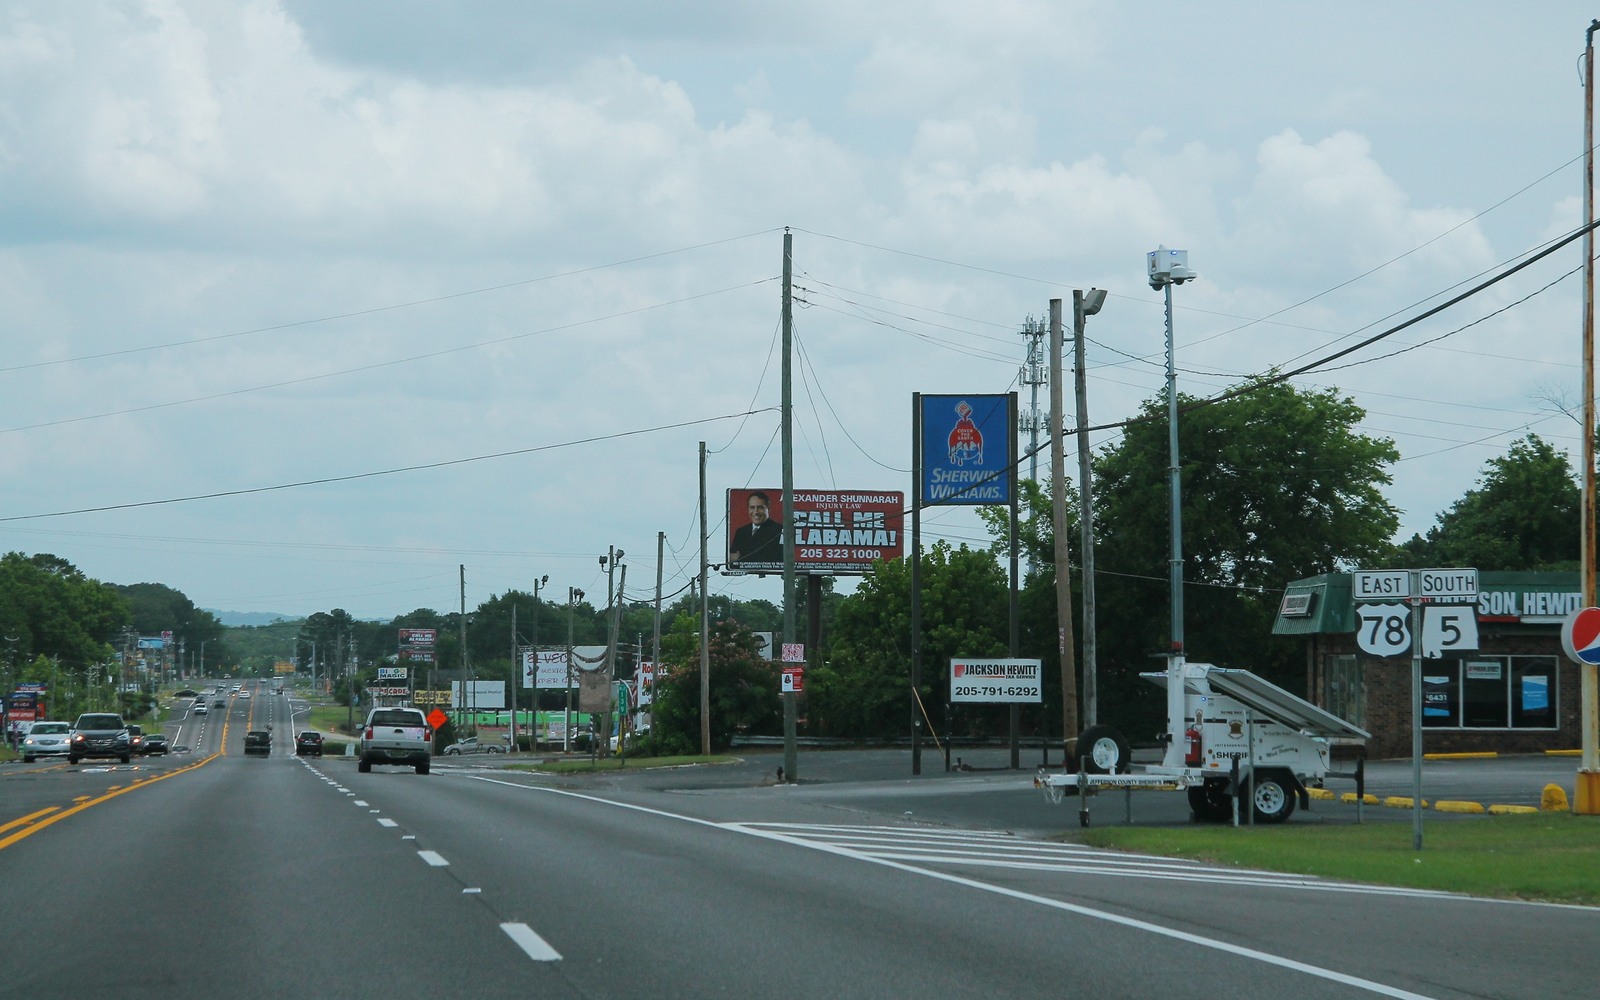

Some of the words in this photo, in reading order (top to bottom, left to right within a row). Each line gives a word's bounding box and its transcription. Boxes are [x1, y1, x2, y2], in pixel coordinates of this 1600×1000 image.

[930, 468, 1000, 483] SHERWIN
[780, 494, 838, 502] EXANDER
[840, 494, 898, 504] SHUNNARAH
[793, 511, 845, 528] CALL
[853, 512, 885, 528] ME
[800, 548, 823, 558] 205
[826, 548, 849, 558] 323
[852, 549, 881, 558] 1000
[1362, 576, 1402, 593] EAST
[1423, 574, 1474, 592] SOUTH
[1523, 592, 1583, 614] HEWIT
[1363, 615, 1404, 646] 78
[1441, 616, 1461, 646] 5
[965, 664, 1005, 675] JACKSON
[1008, 665, 1037, 675] HEWITT
[955, 686, 1038, 696] 205-791-6292
